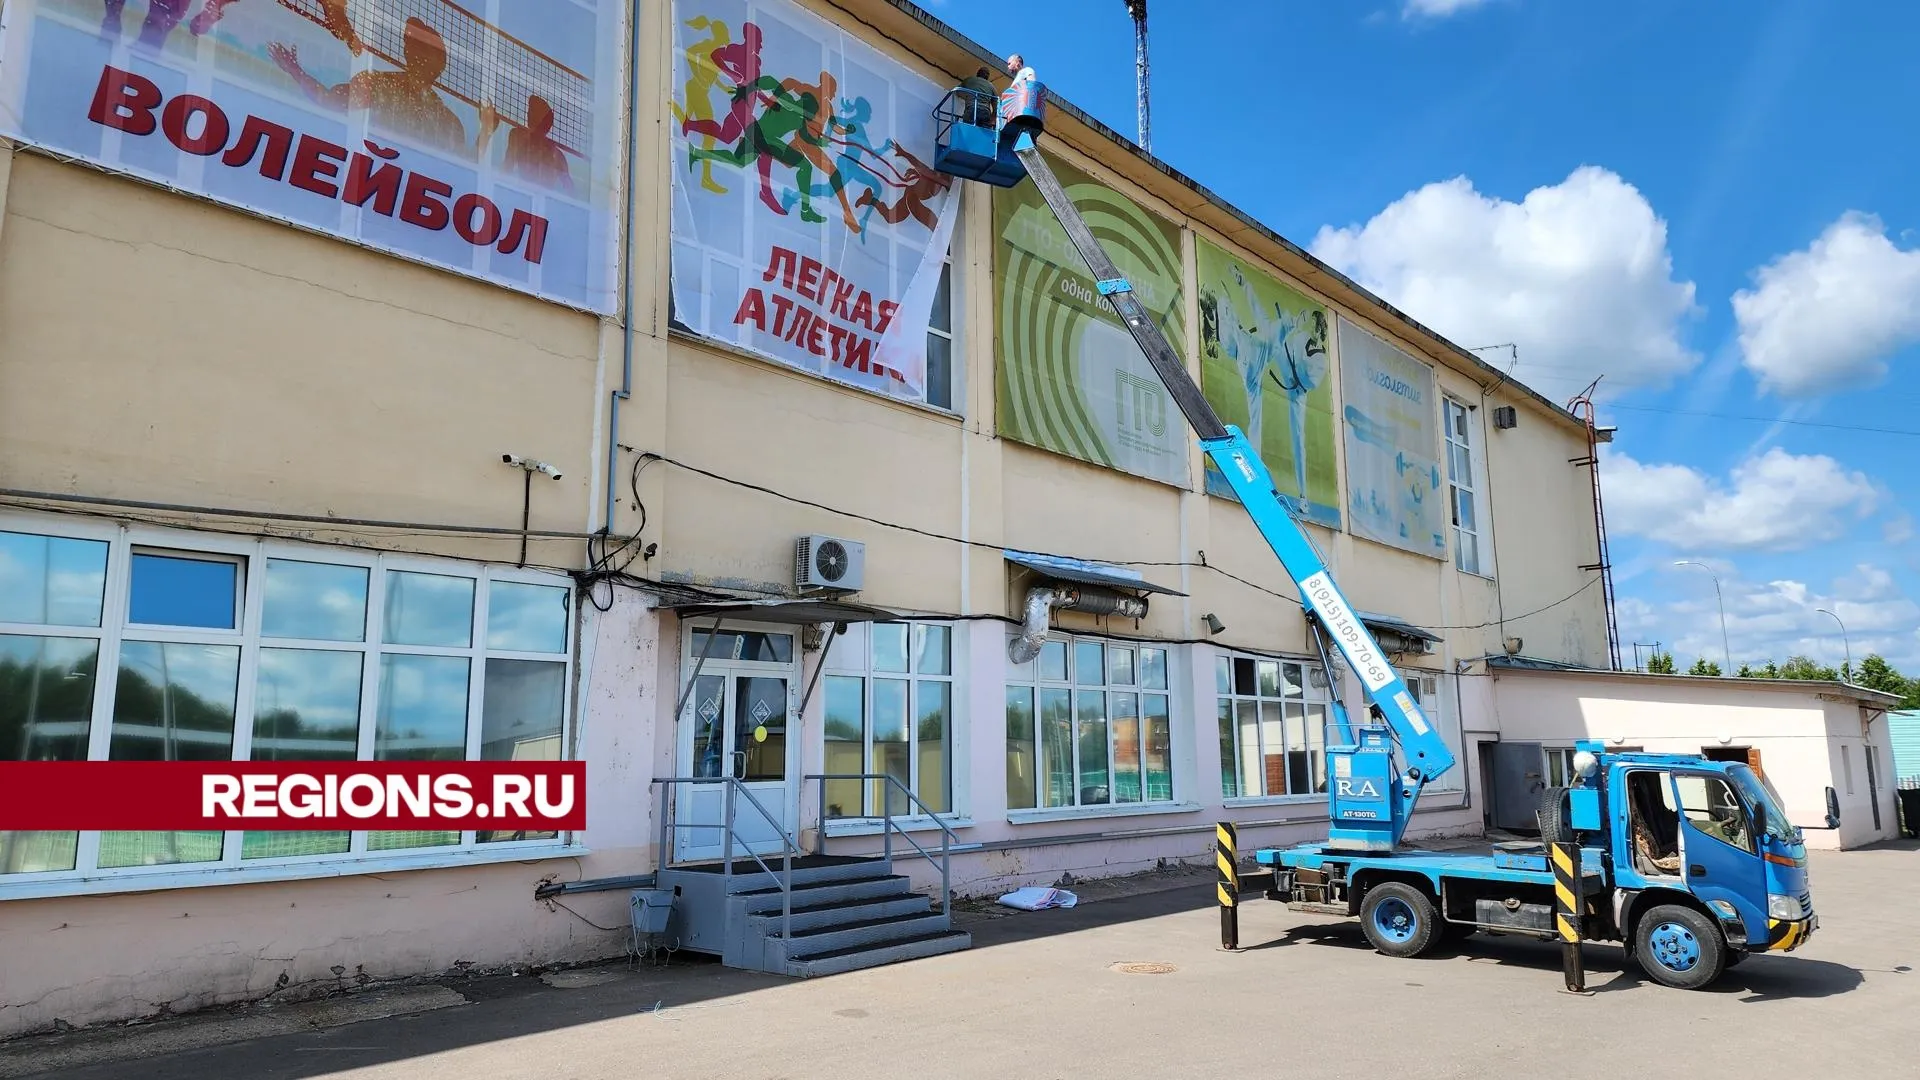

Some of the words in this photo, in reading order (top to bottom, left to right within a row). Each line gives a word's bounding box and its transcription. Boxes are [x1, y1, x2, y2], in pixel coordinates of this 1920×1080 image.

[87, 64, 549, 265] ВОЛЕЙБОЛ
[762, 245, 900, 335] ЛЕГКАЯ
[1061, 277, 1092, 303] одна
